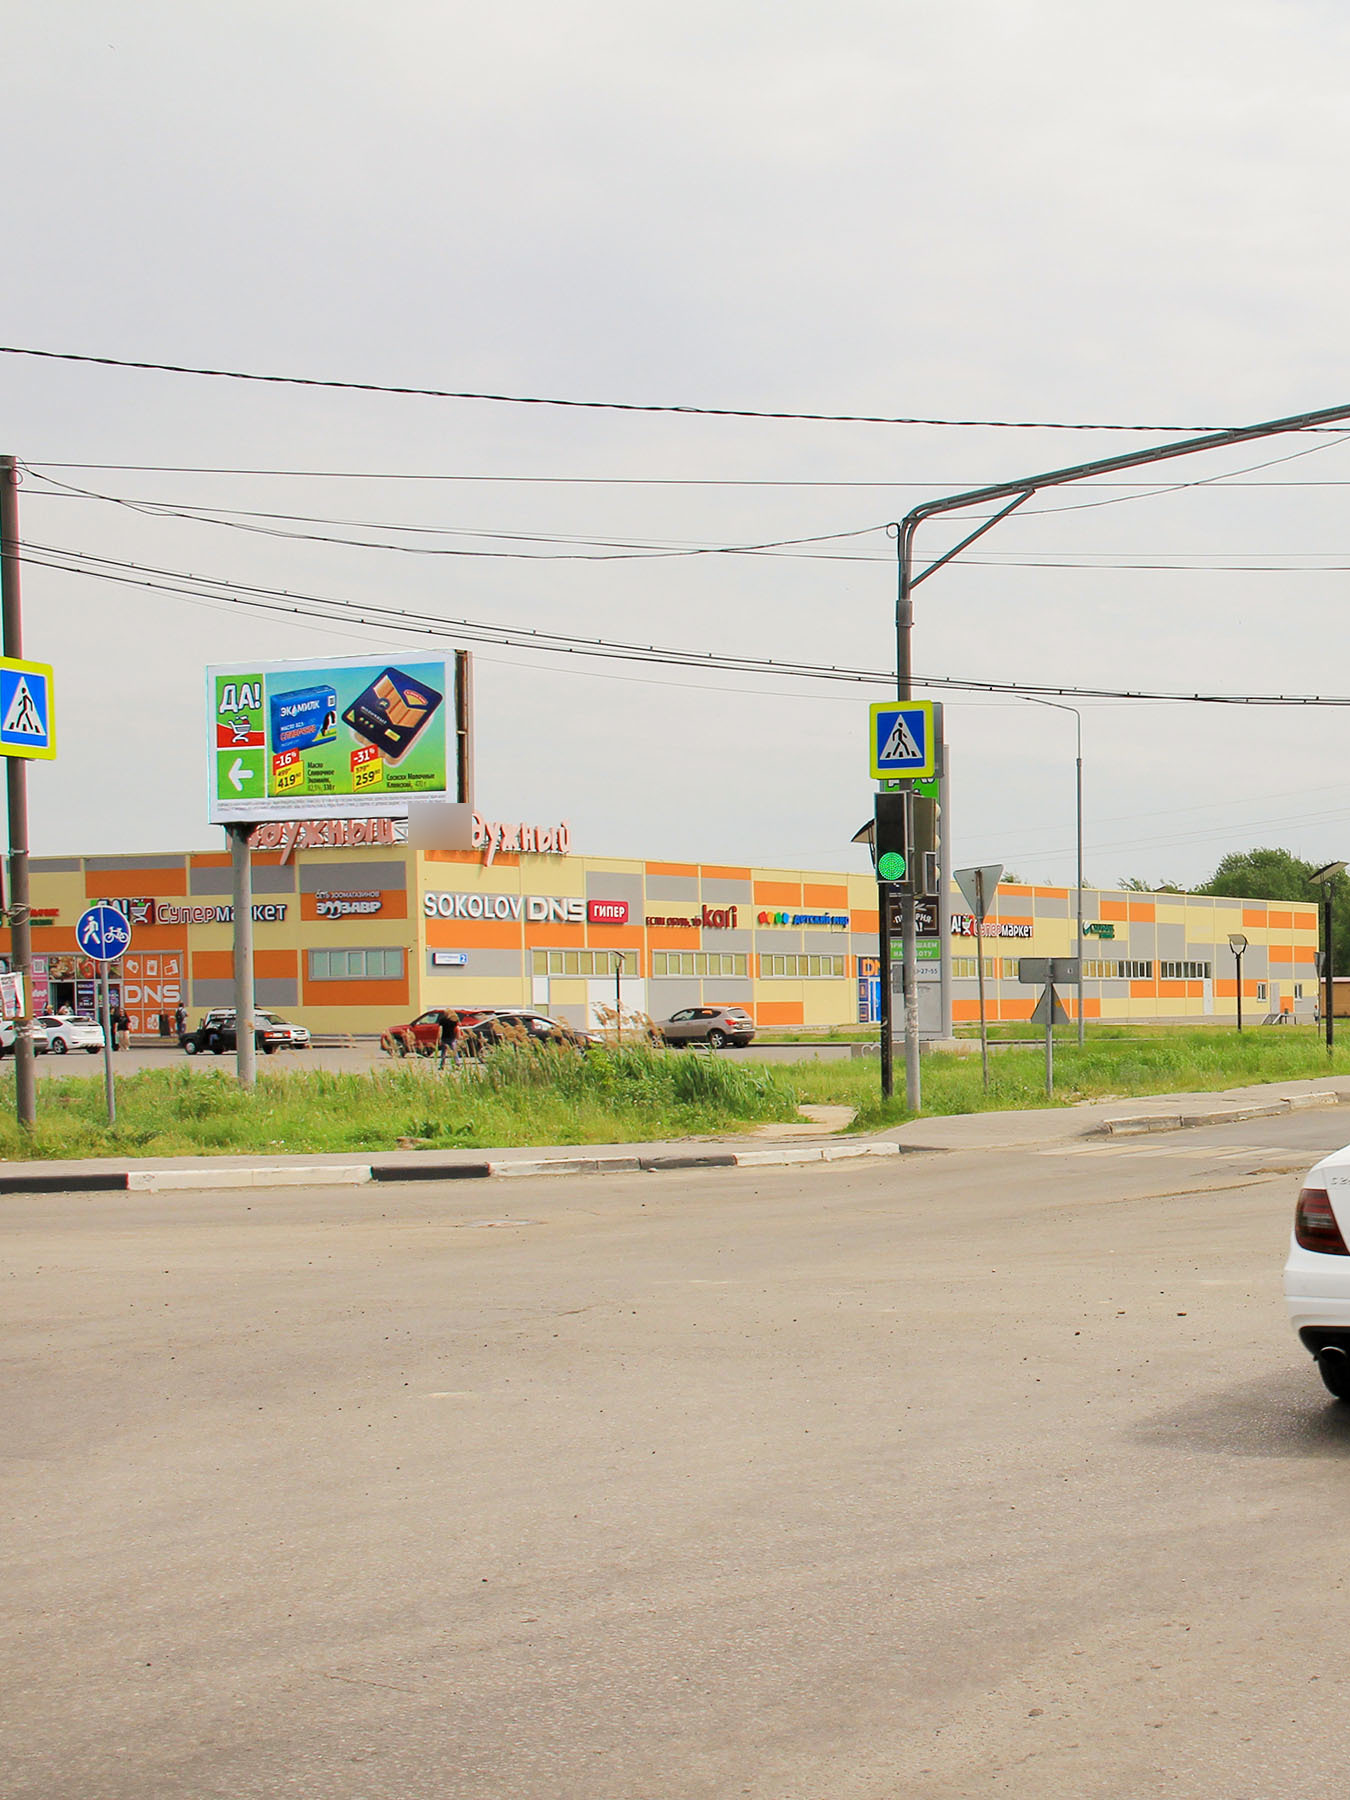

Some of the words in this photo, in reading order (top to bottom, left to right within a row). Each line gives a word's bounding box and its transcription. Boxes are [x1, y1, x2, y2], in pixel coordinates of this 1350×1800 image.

[218, 682, 261, 714] ДА!
[278, 775, 296, 788] 419
[355, 771, 375, 786] 259
[247, 818, 395, 866] дужный
[472, 810, 571, 868] дужный
[156, 901, 288, 925] Супермкет
[424, 892, 523, 920] SOKOLOV
[526, 896, 586, 923] DNS
[593, 904, 626, 918] ГИПЕР
[702, 904, 738, 929] kari
[894, 912, 933, 924] ПРНЯ
[124, 984, 182, 1004] DNS
